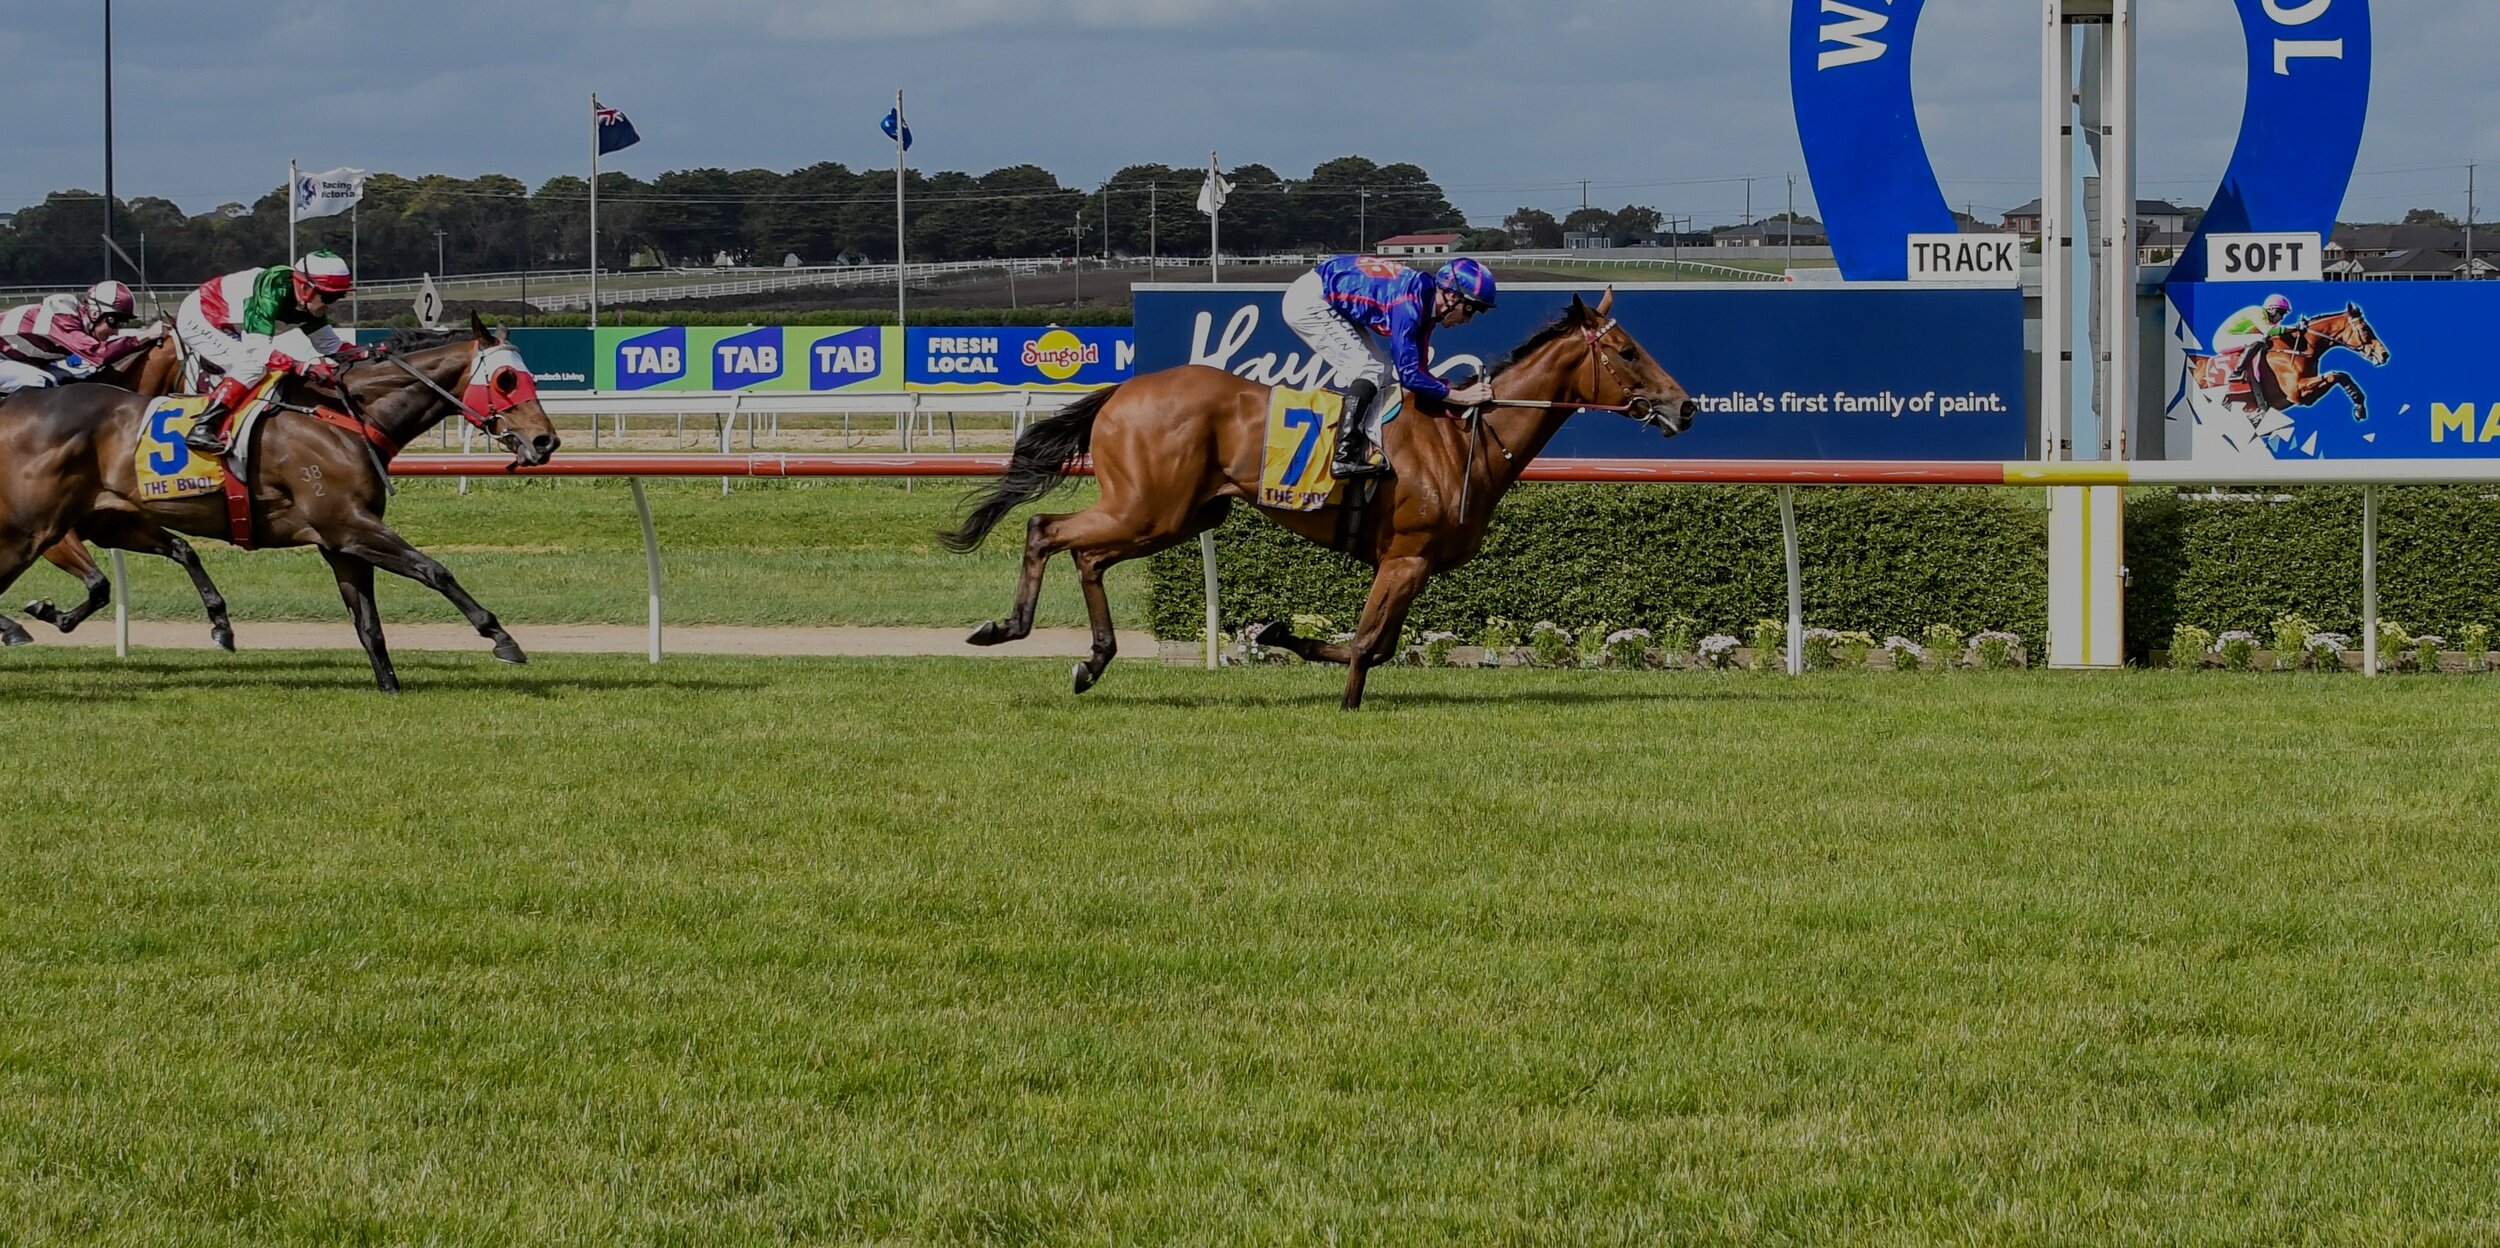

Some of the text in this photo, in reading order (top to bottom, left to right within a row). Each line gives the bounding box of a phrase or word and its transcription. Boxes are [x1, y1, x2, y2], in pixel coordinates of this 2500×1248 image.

[1818, 0, 1893, 71] W
[1912, 242, 2013, 272] TRACK
[2225, 242, 2304, 273] SOFT
[424, 292, 433, 322] 2
[620, 345, 681, 374] TAB
[717, 345, 778, 374] TAB
[815, 345, 876, 374] TAB
[927, 337, 999, 354] FRESH
[1021, 339, 1099, 370] Sungold
[562, 372, 585, 383] Living
[927, 356, 999, 373] LOCAL
[1780, 390, 1828, 412] first
[1832, 390, 1905, 418] family
[1908, 390, 1934, 412] of
[1939, 391, 2007, 418] paint.
[149, 407, 189, 476] 5
[1279, 407, 1324, 486] 7
[143, 482, 168, 496] THE
[1265, 488, 1295, 503] THE
